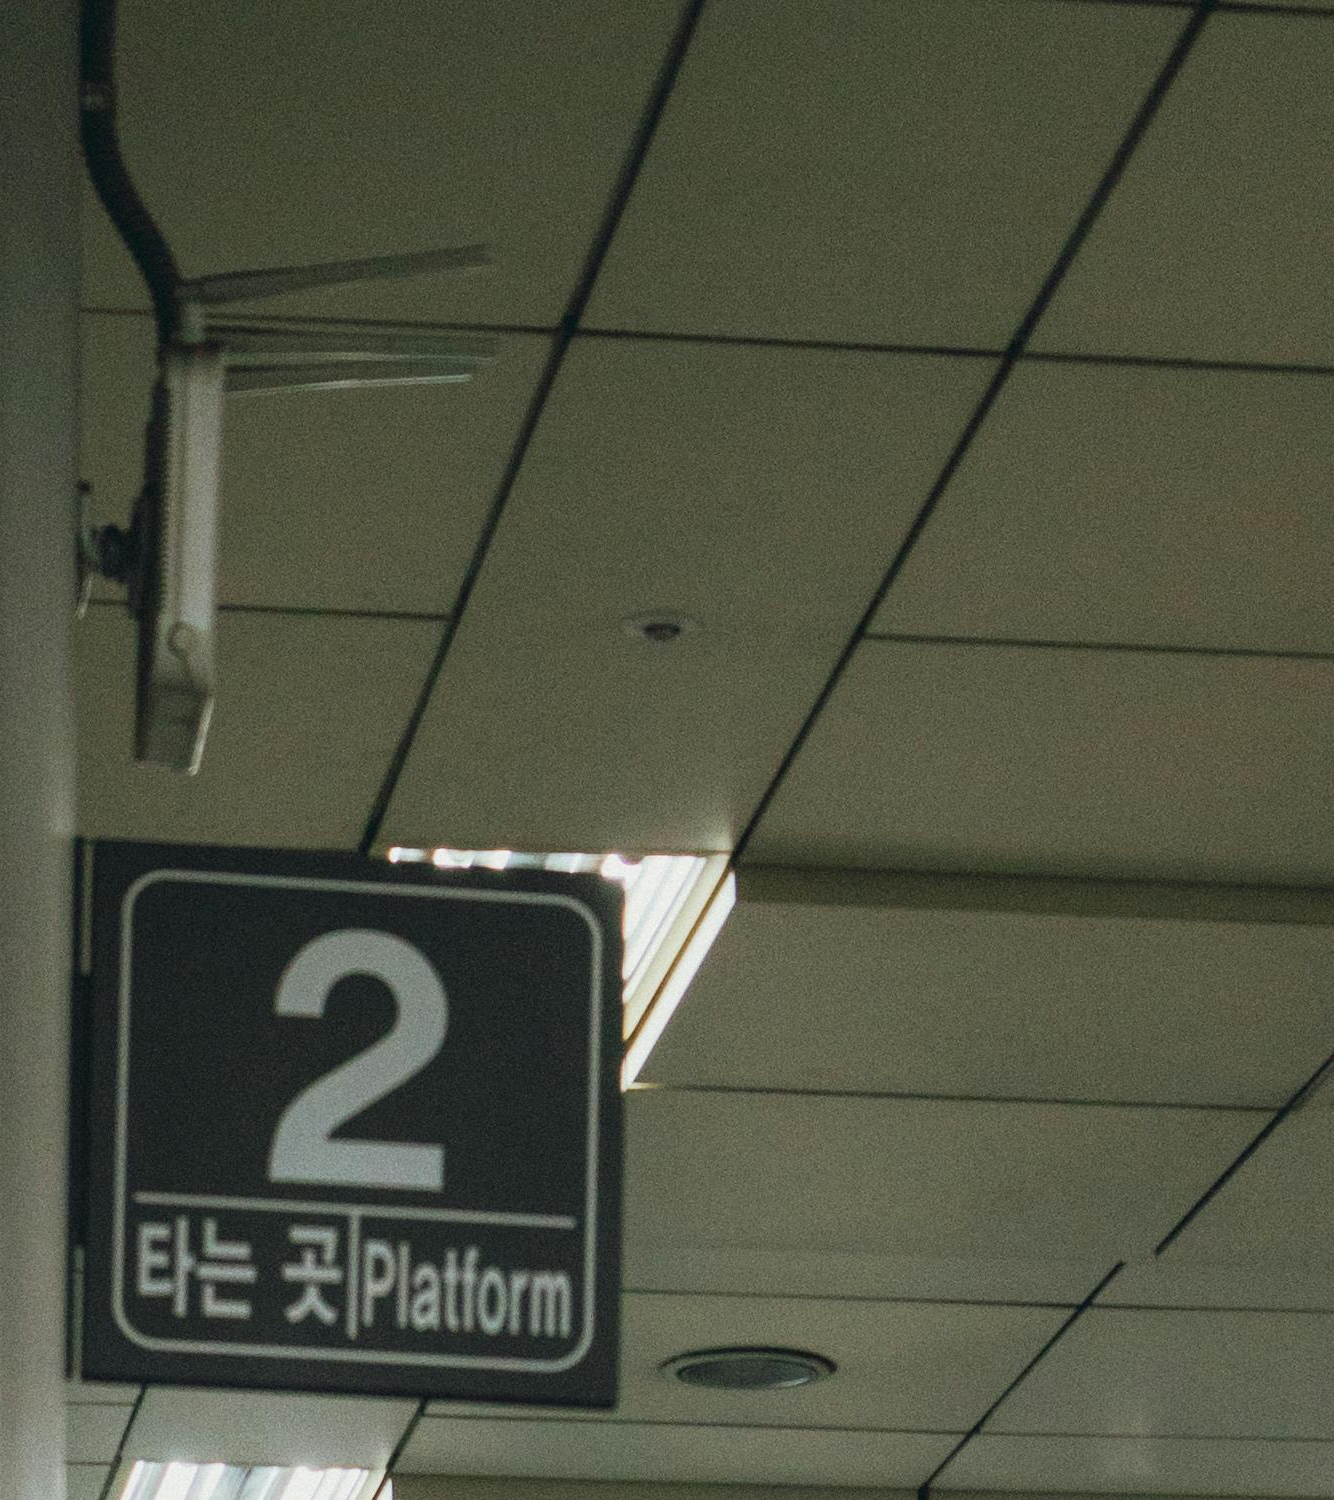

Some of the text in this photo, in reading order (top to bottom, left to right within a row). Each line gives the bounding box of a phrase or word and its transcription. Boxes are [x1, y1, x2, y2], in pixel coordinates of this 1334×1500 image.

[269, 928, 449, 1194] 2
[137, 1215, 343, 1327] 타는 곳
[364, 1239, 571, 1338] Platform
